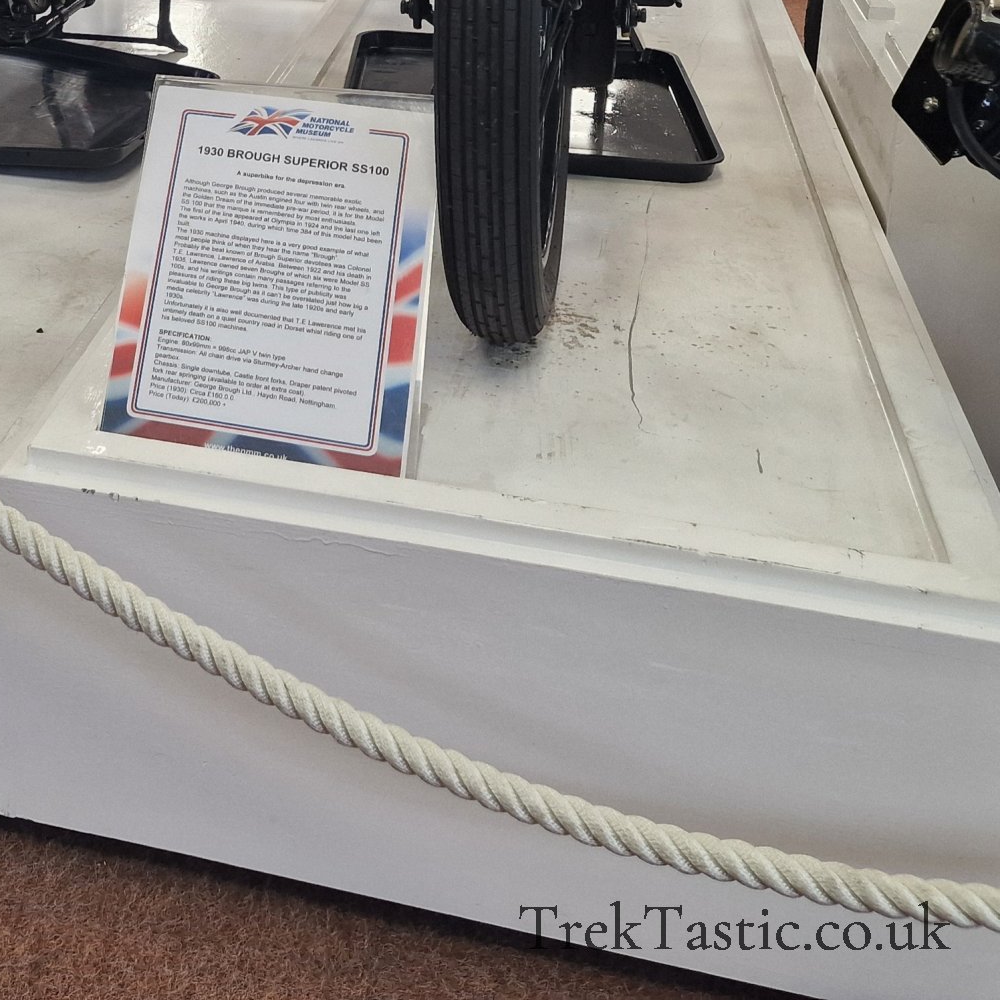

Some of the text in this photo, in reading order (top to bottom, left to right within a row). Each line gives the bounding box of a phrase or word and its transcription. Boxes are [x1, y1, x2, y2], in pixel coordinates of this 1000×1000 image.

[310, 116, 350, 127] NATIONAL
[295, 128, 332, 138] MUSEUM
[301, 122, 355, 134] MOTORCYCLE
[198, 145, 389, 175] 1930 BROUGH SUPERIOR SS100
[242, 171, 273, 181] superbike
[296, 178, 332, 188] depression
